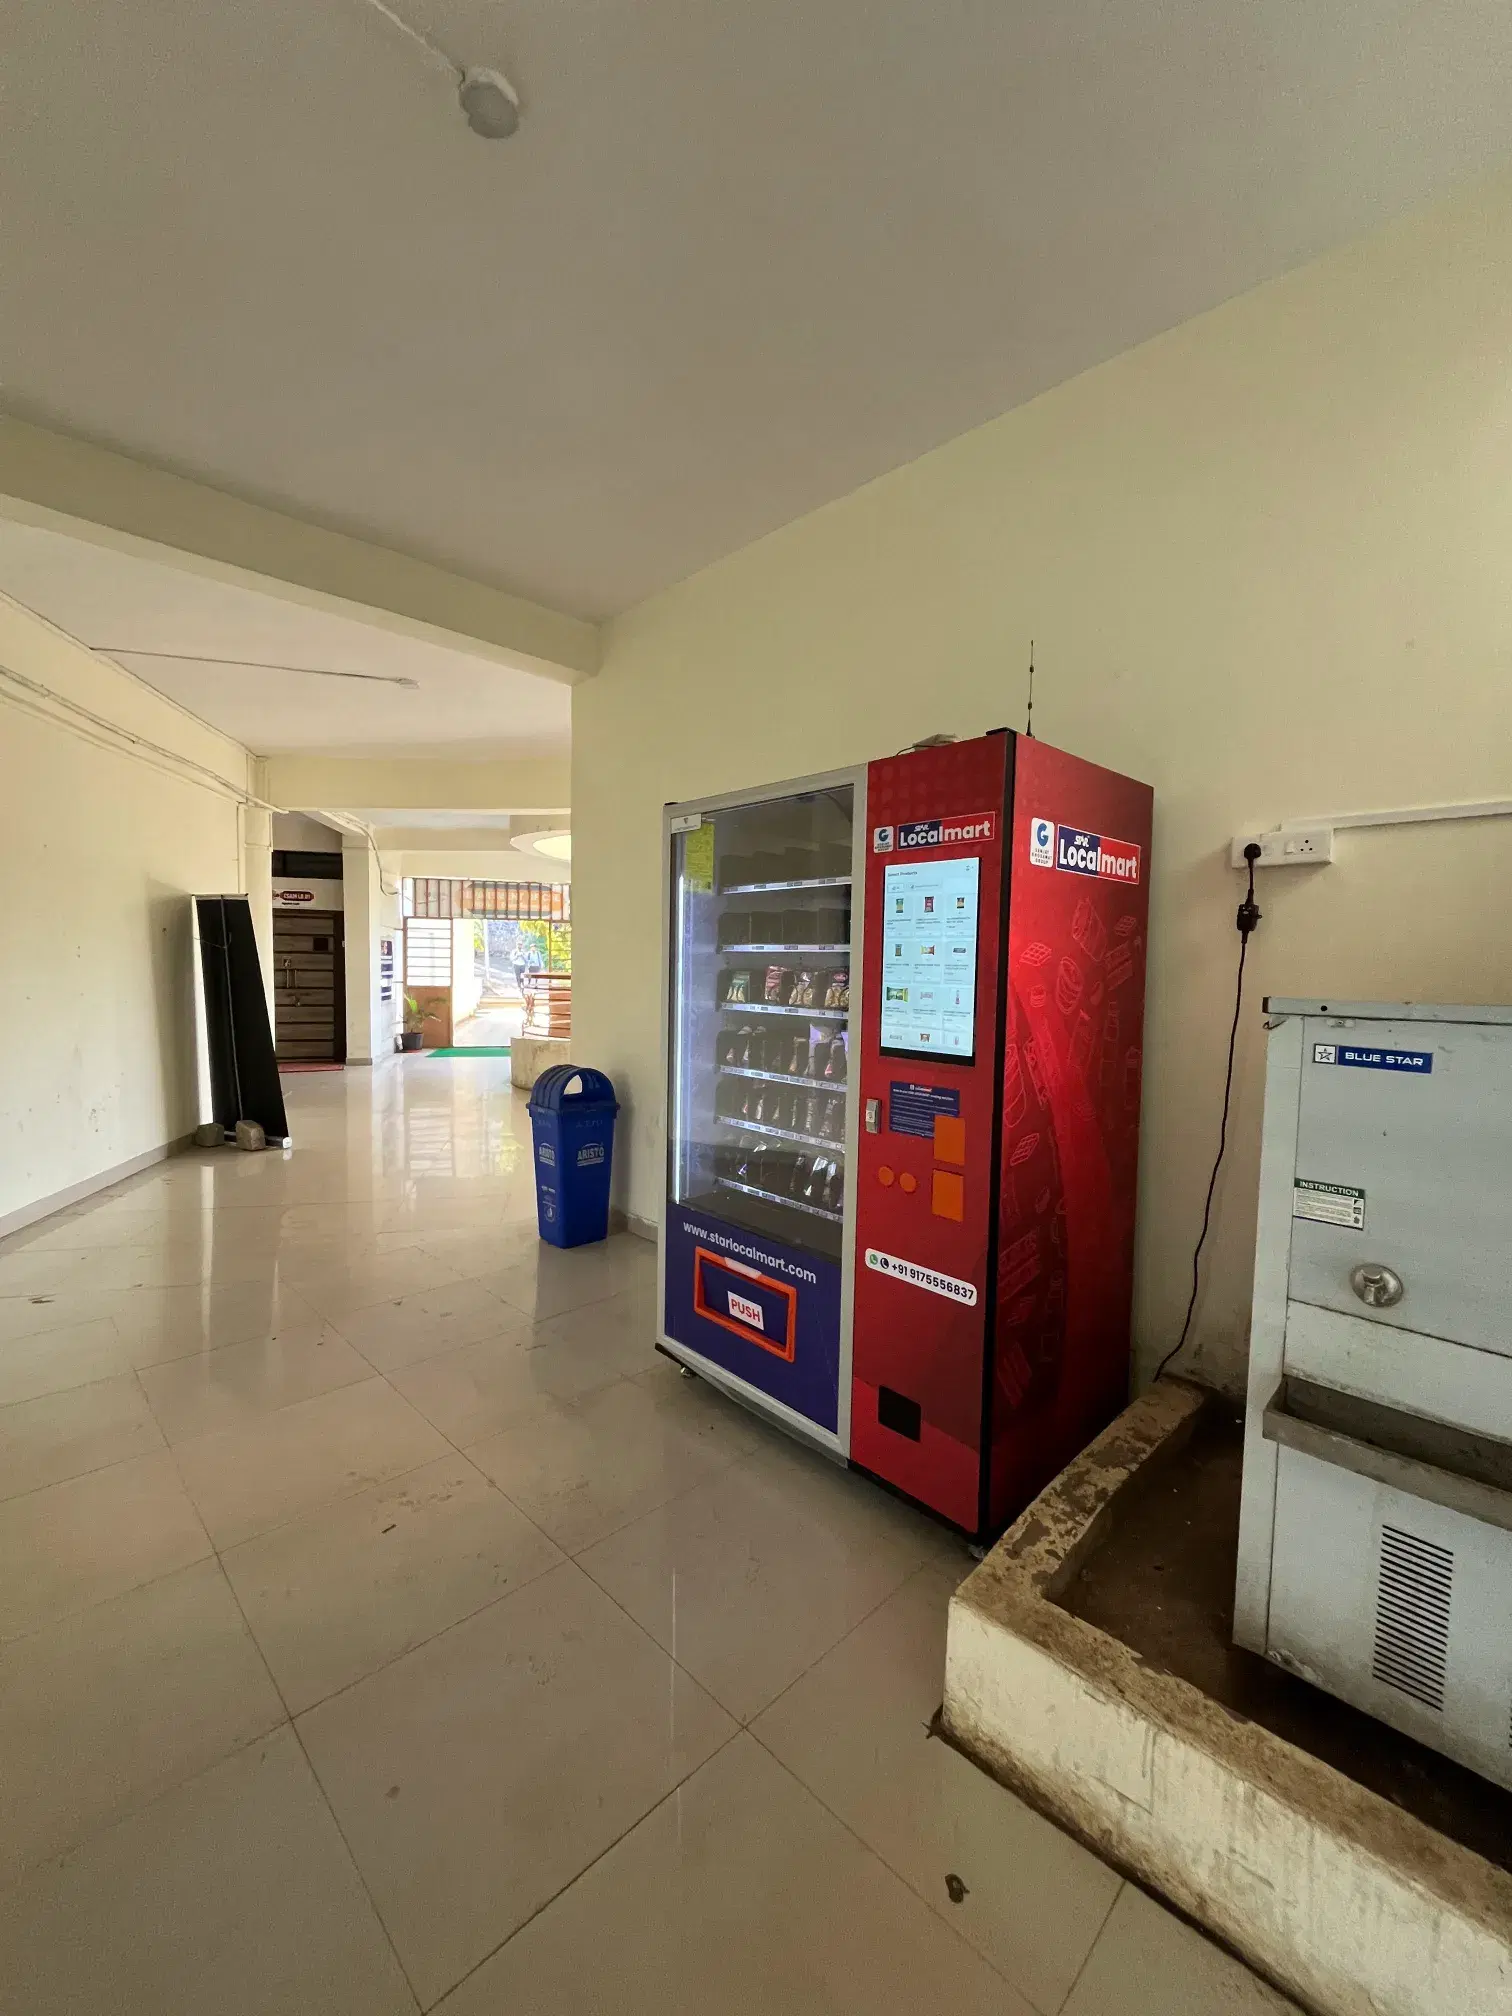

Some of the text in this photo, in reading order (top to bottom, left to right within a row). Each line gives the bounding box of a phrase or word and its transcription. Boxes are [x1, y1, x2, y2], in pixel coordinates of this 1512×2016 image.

[900, 821, 990, 847] Localmart
[1060, 839, 1137, 878] Localmart
[1345, 1052, 1424, 1066] BLUE STAR
[577, 1146, 605, 1161] ARISTO
[1300, 1181, 1359, 1197] INSTRUCTION
[683, 1221, 817, 1284] www.starlocalmart.com
[891, 1263, 974, 1300] +91 9175556837
[731, 1298, 761, 1322] PUSH
